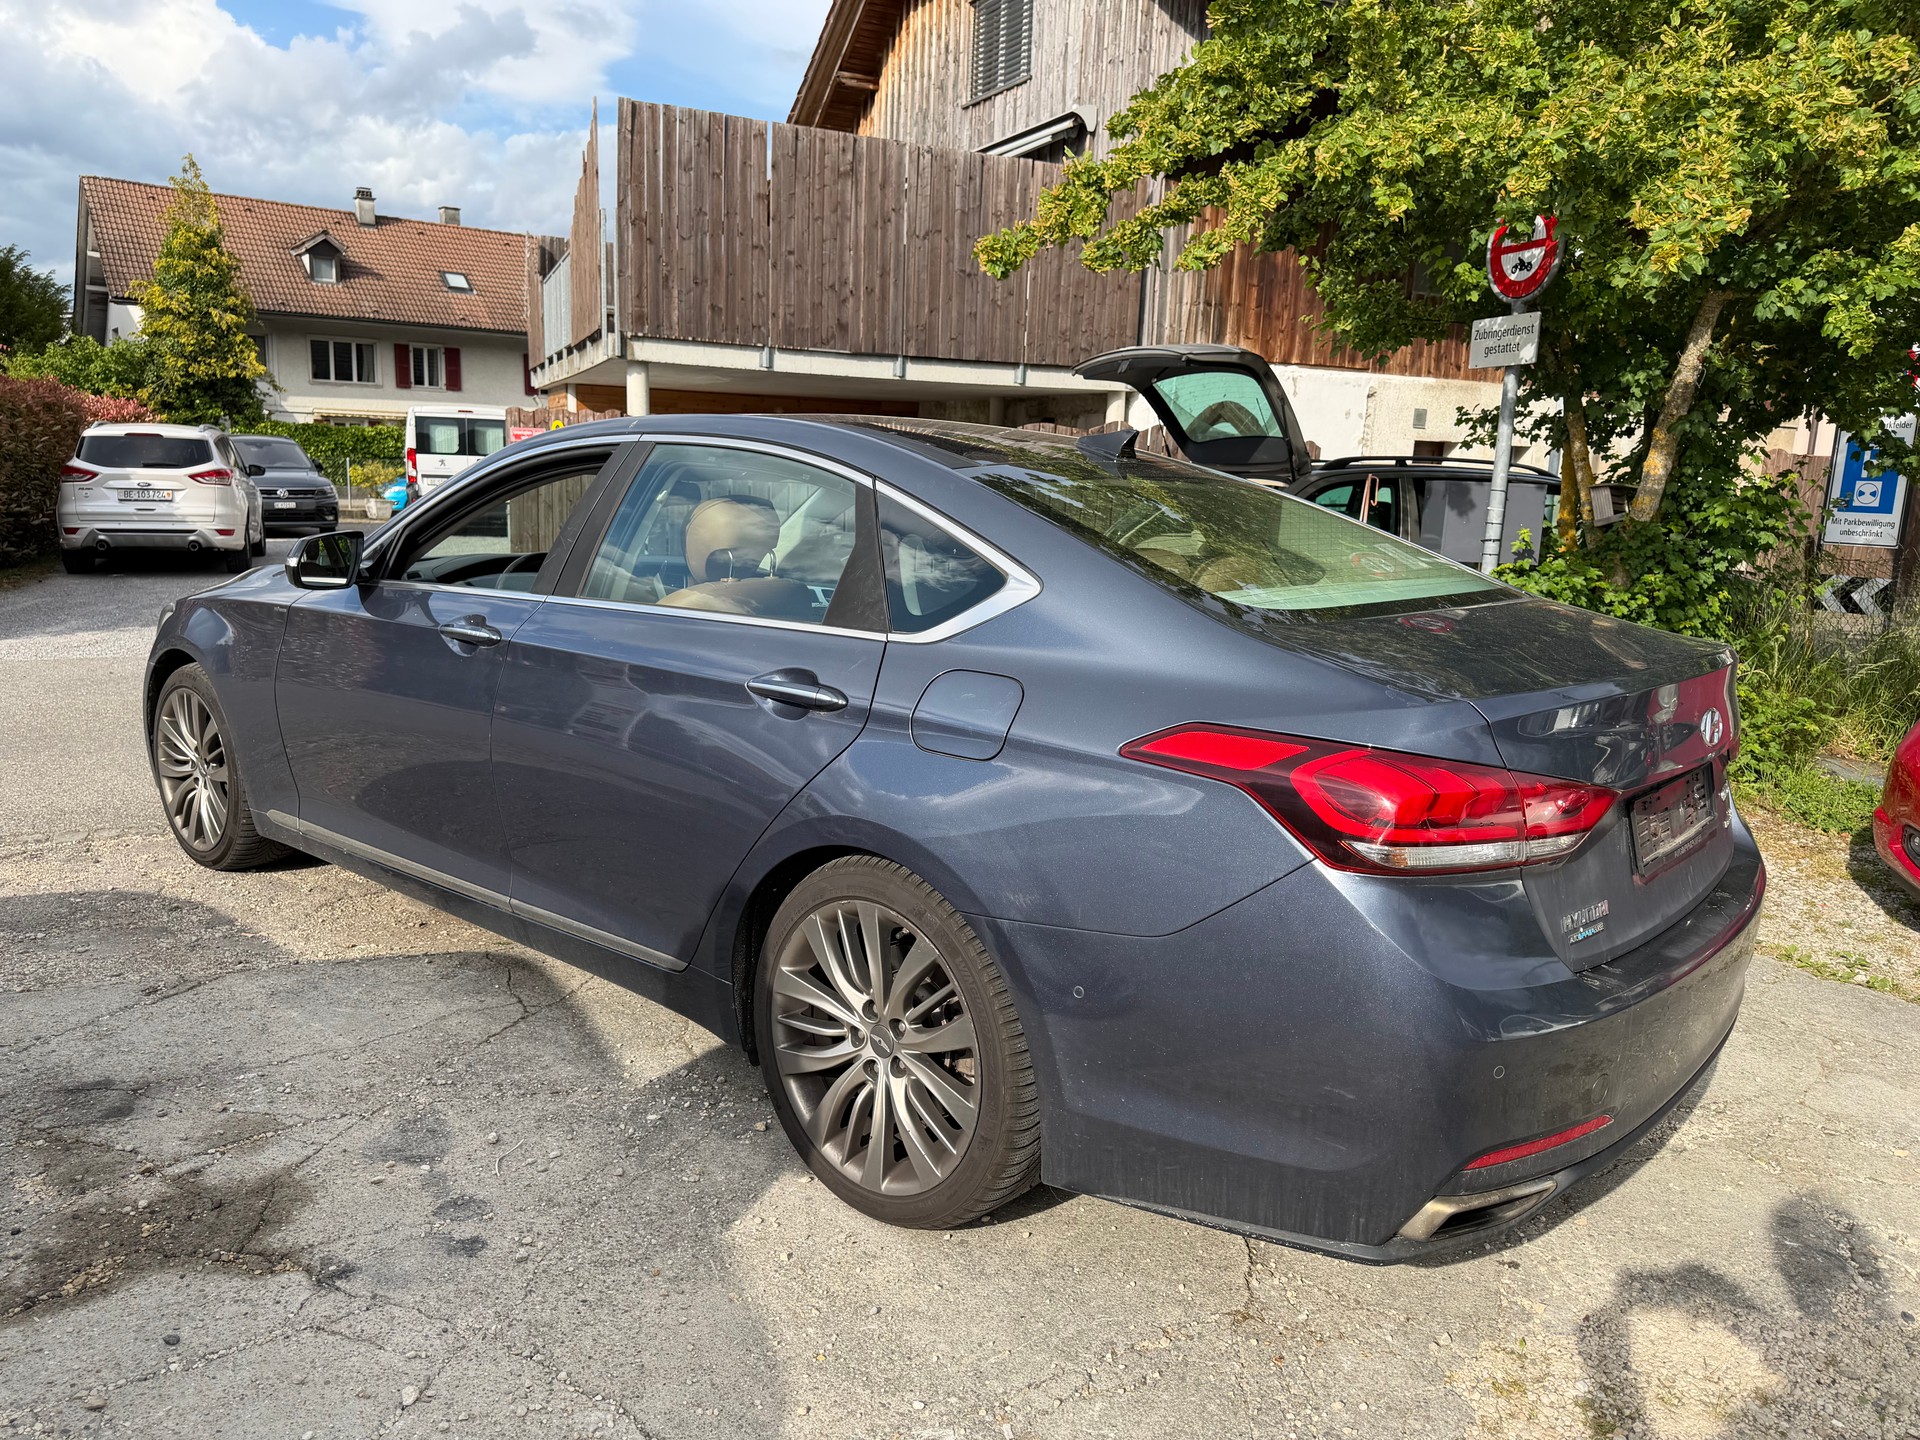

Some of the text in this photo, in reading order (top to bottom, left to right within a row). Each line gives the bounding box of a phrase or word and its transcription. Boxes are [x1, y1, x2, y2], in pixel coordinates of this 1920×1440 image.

[1474, 323, 1535, 341] Zubringerdienst
[1484, 342, 1520, 358] gestattet
[1830, 517, 1896, 530] Mit Parkbewilligung
[1839, 528, 1883, 538] unbeschränkt
